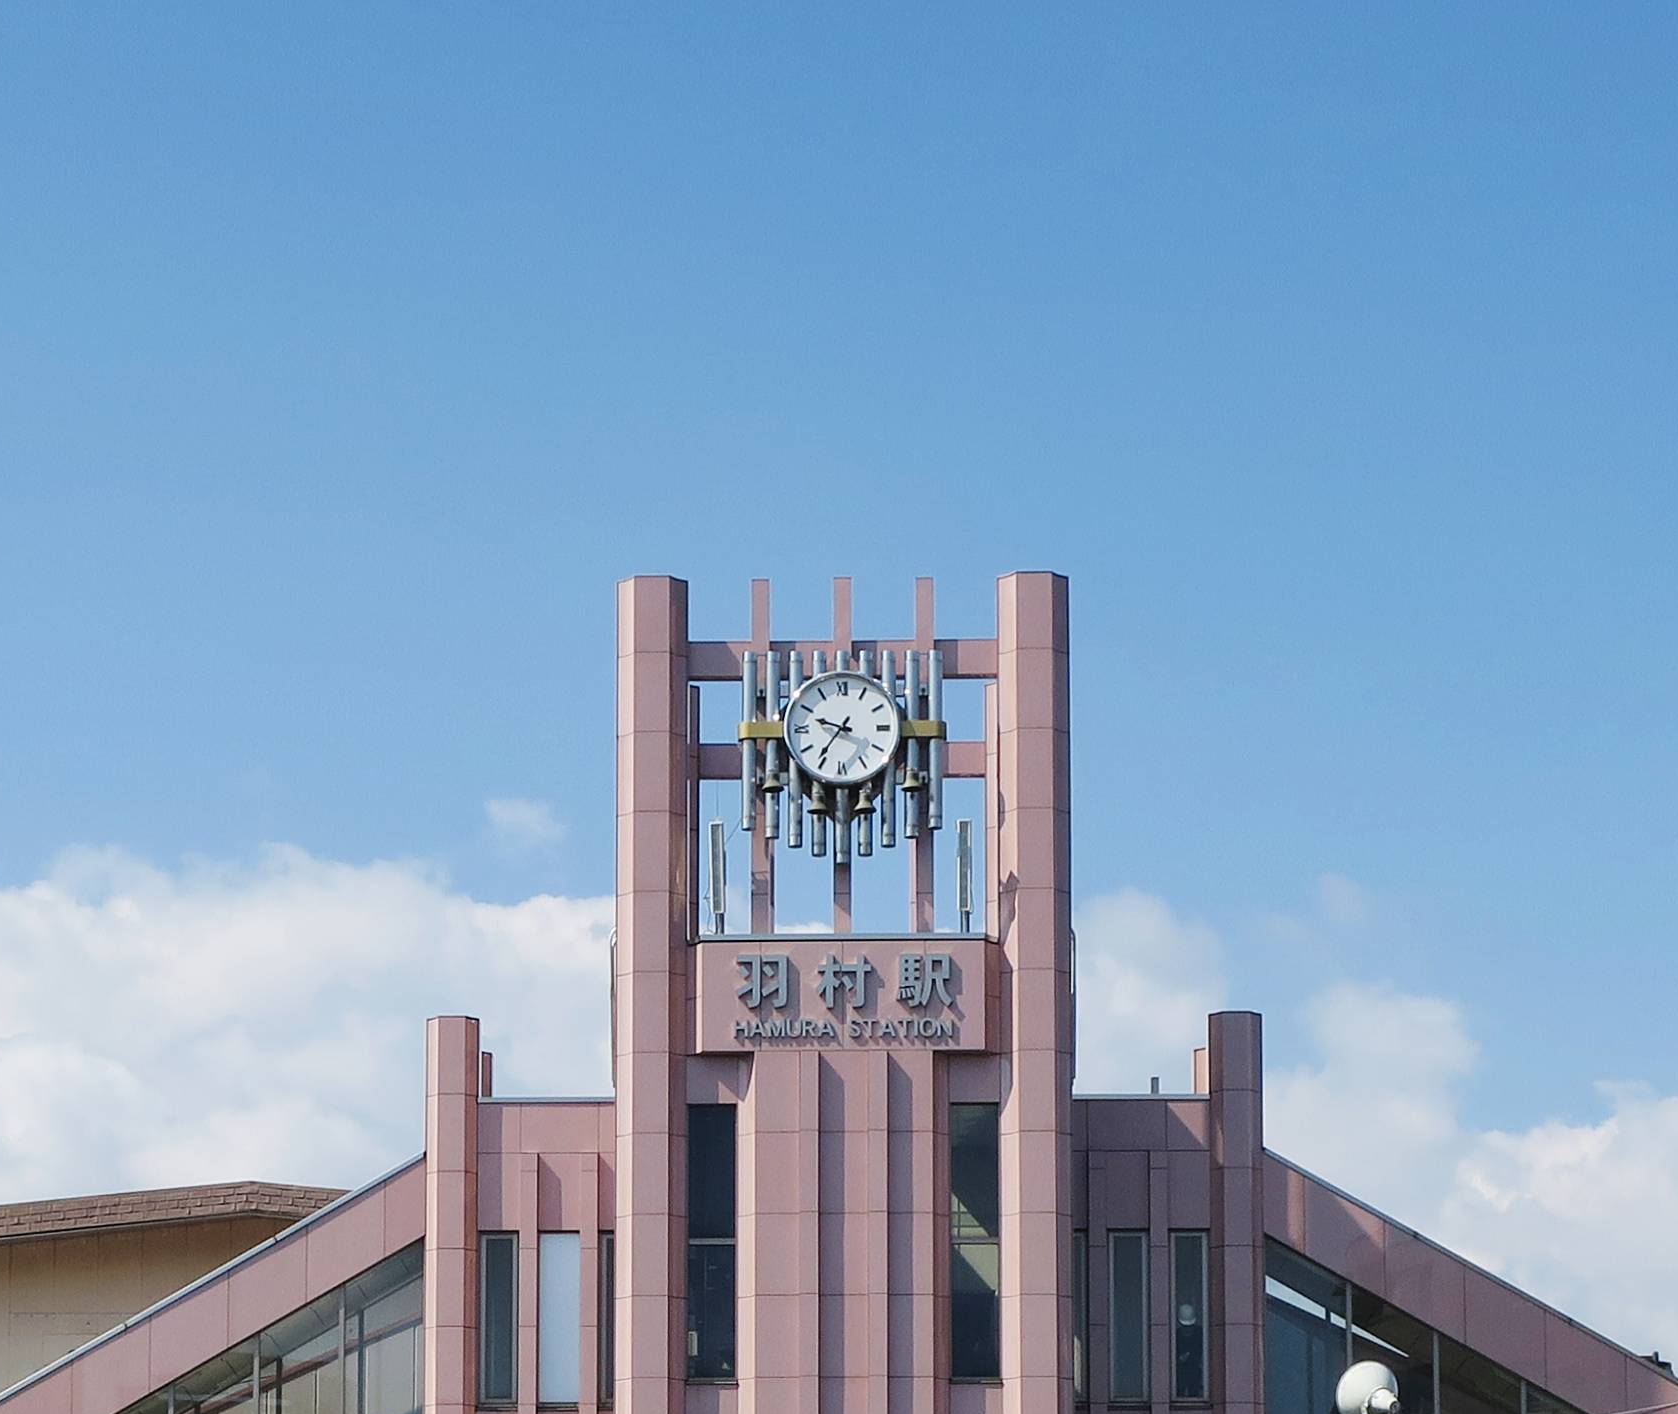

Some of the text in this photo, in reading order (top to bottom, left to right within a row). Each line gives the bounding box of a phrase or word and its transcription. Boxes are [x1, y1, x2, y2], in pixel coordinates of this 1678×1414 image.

[735, 953, 955, 1010] 羽村駅
[732, 1018, 955, 1040] HAMURA STATION
